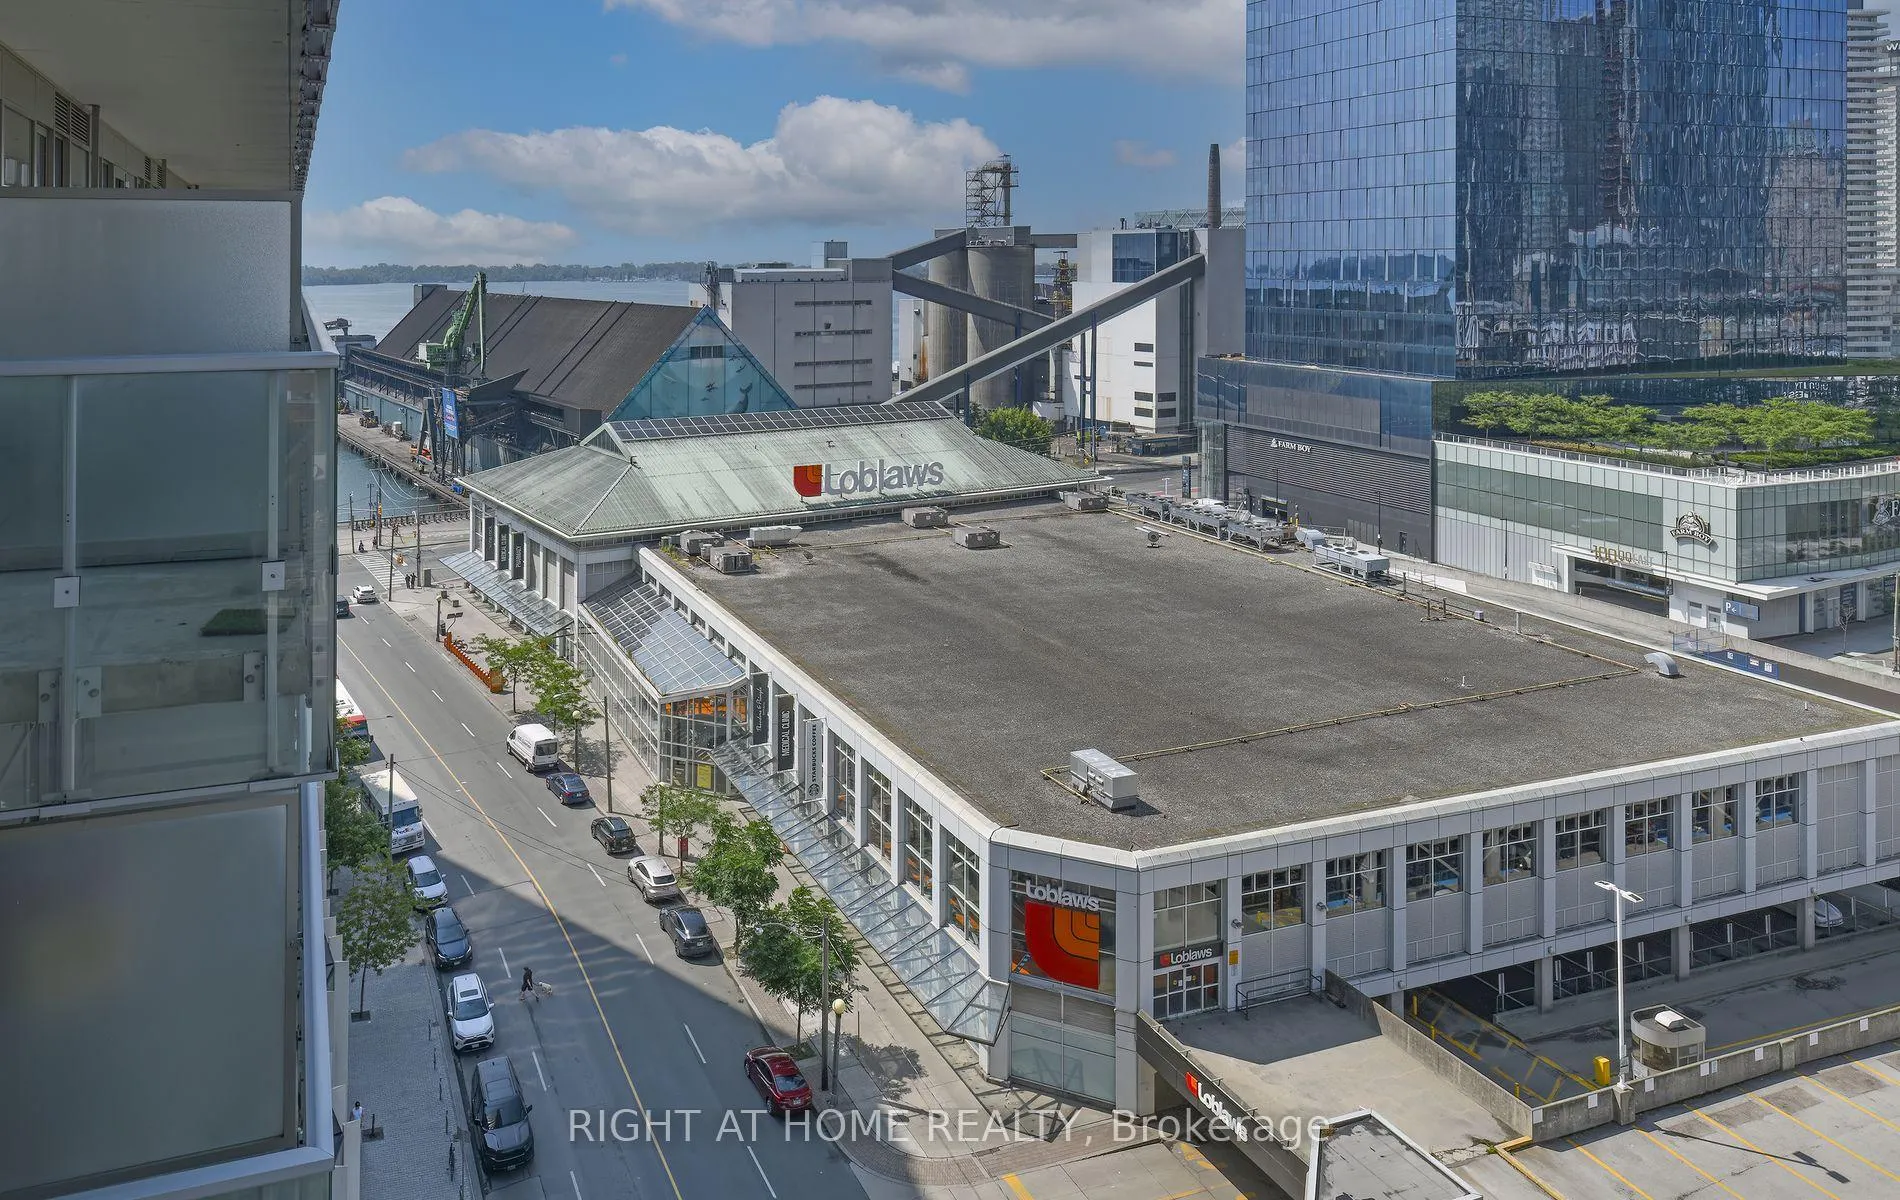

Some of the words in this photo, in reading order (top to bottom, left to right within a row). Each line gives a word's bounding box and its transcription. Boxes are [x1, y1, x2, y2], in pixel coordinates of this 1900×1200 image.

[1278, 440, 1296, 450] FARM
[1297, 444, 1312, 453] BOY
[824, 459, 944, 496] Loblaws
[1671, 528, 1694, 537] FARM
[1694, 531, 1712, 543] BOY
[1725, 602, 1731, 612] P
[781, 710, 790, 729] CLINIC
[781, 730, 790, 757] MEDICAL
[1025, 880, 1100, 912] Loblaws
[1170, 947, 1212, 965] Loblaws
[1198, 1082, 1248, 1142] Loblaws
